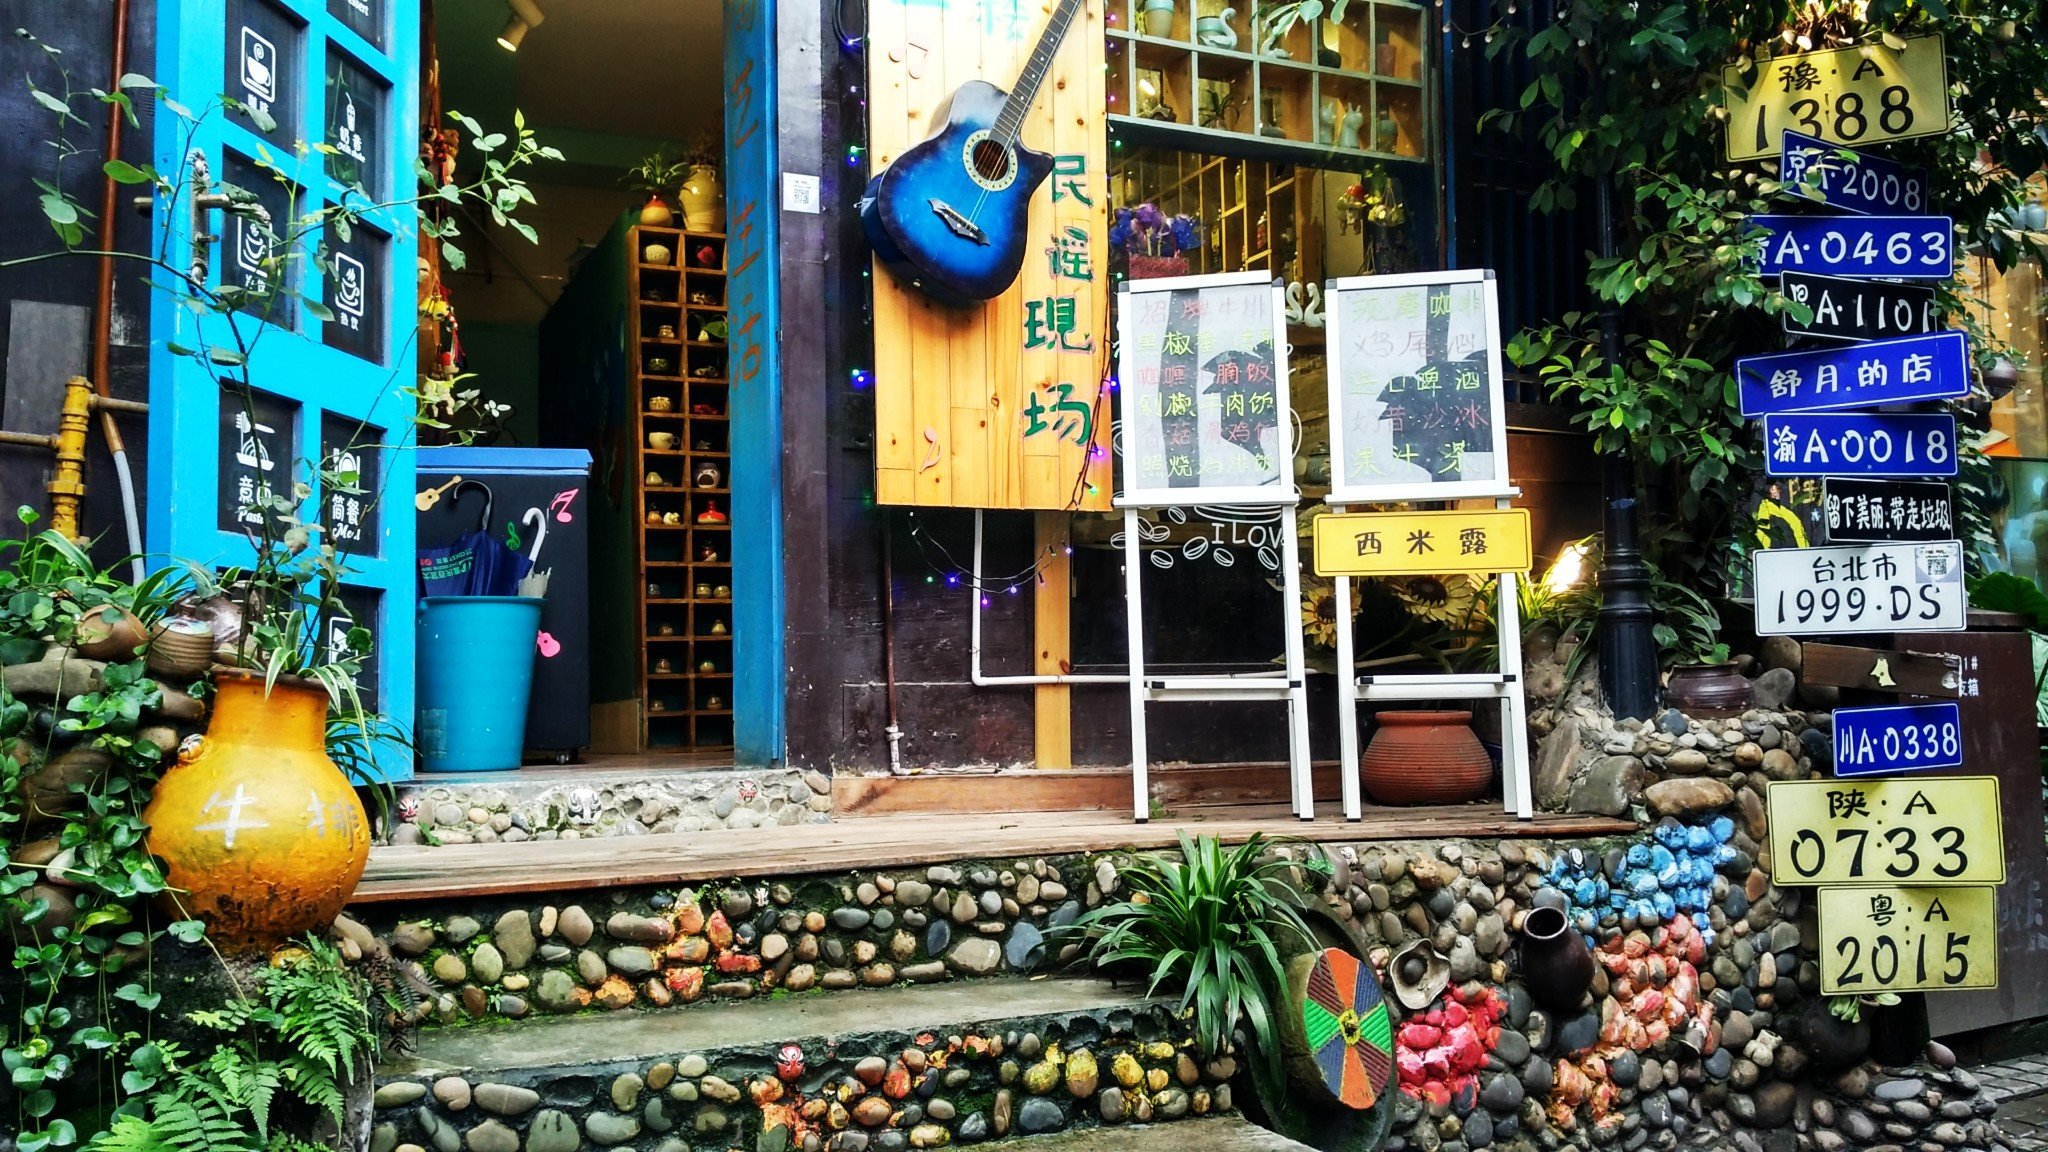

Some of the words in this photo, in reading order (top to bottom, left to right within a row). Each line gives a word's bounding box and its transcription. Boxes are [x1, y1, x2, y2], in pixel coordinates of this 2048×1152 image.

[1755, 85, 1914, 153] 1388
[1772, 425, 1949, 464] 渝A·0018
[331, 493, 360, 526] 简餐
[1232, 522, 1284, 549] LOV
[1353, 527, 1489, 557] 西米露
[1812, 552, 1898, 584] 台北市
[1839, 722, 1959, 765] 川A·0338
[1789, 825, 1969, 878] 0733
[1836, 931, 1971, 988] 2015
